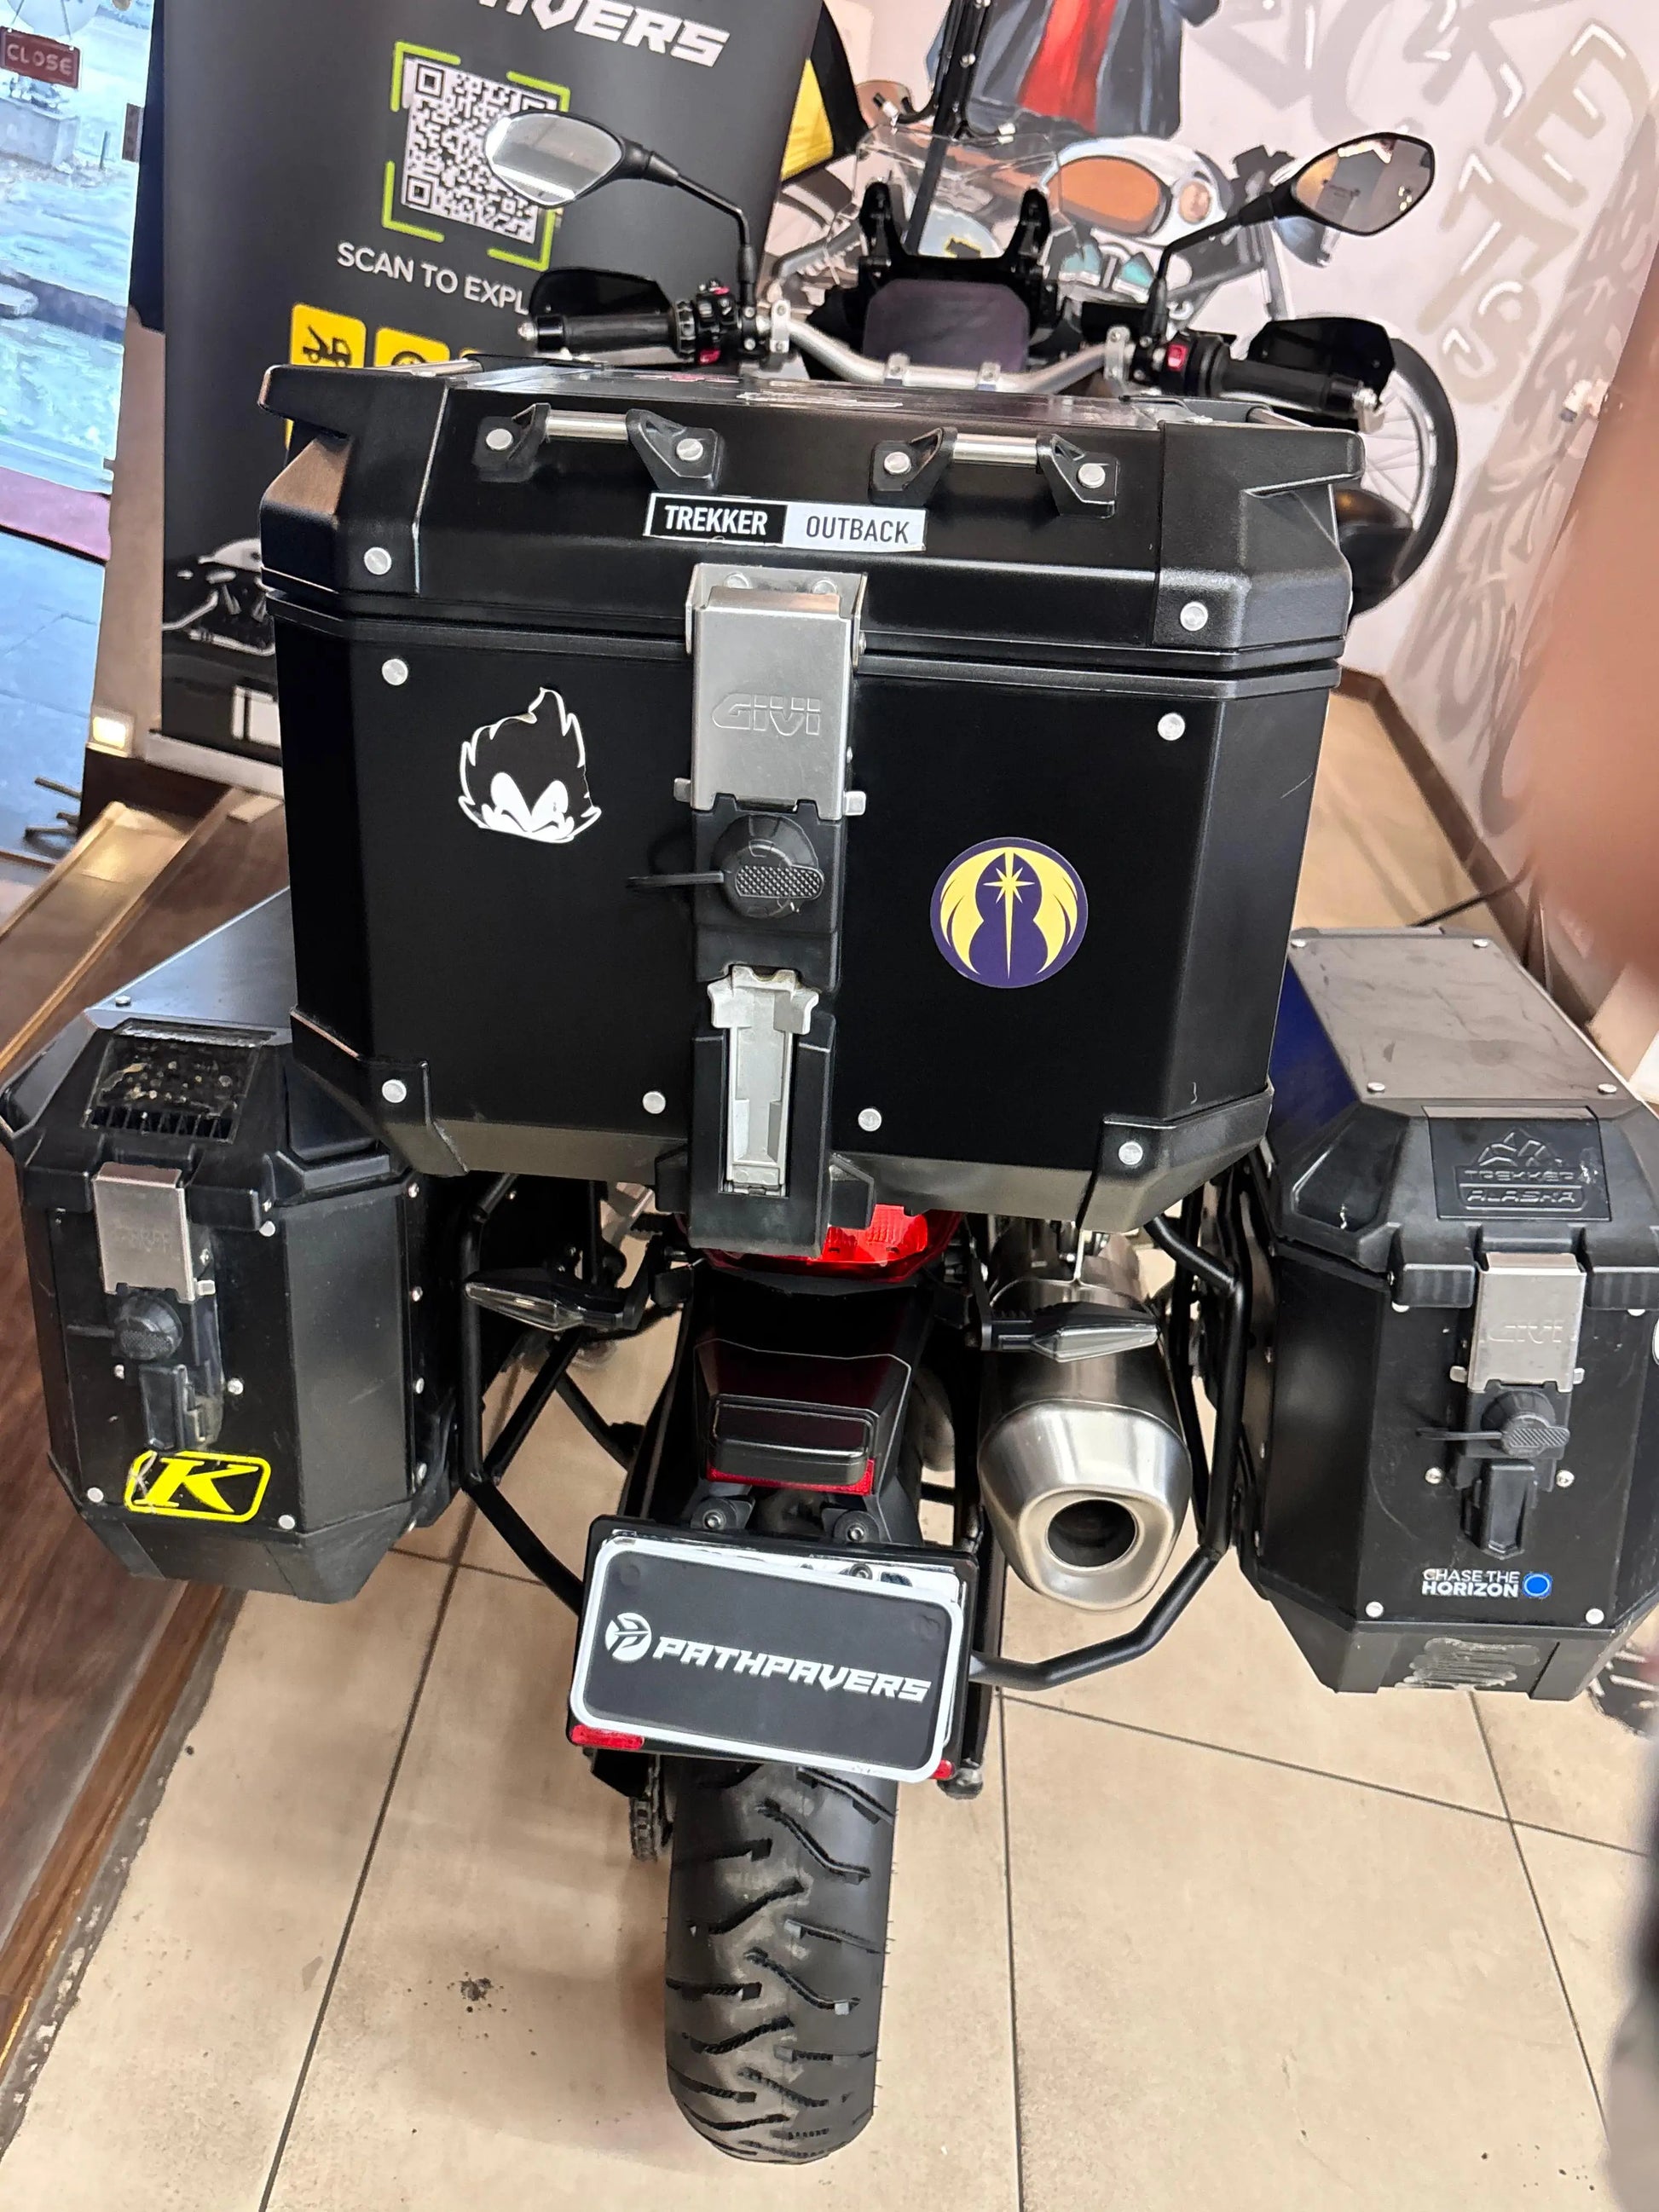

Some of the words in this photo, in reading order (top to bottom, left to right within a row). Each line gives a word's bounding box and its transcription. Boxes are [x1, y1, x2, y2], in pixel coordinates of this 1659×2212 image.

[476, 0, 731, 67] VERS
[6, 43, 74, 76] CLOSE
[337, 241, 414, 283] SCAN
[421, 262, 459, 294] TO
[664, 505, 768, 536] TREKKER
[806, 515, 910, 544] OUTBACK
[711, 692, 822, 736] GIVI
[1463, 1169, 1575, 1183] TREKKER
[1467, 1190, 1576, 1204] ALASKA
[1421, 1580, 1519, 1598] HORIZON
[1423, 1568, 1483, 1583] CHASE
[1486, 1570, 1521, 1584] THE
[652, 1636, 932, 1704] PATHPAVERS
